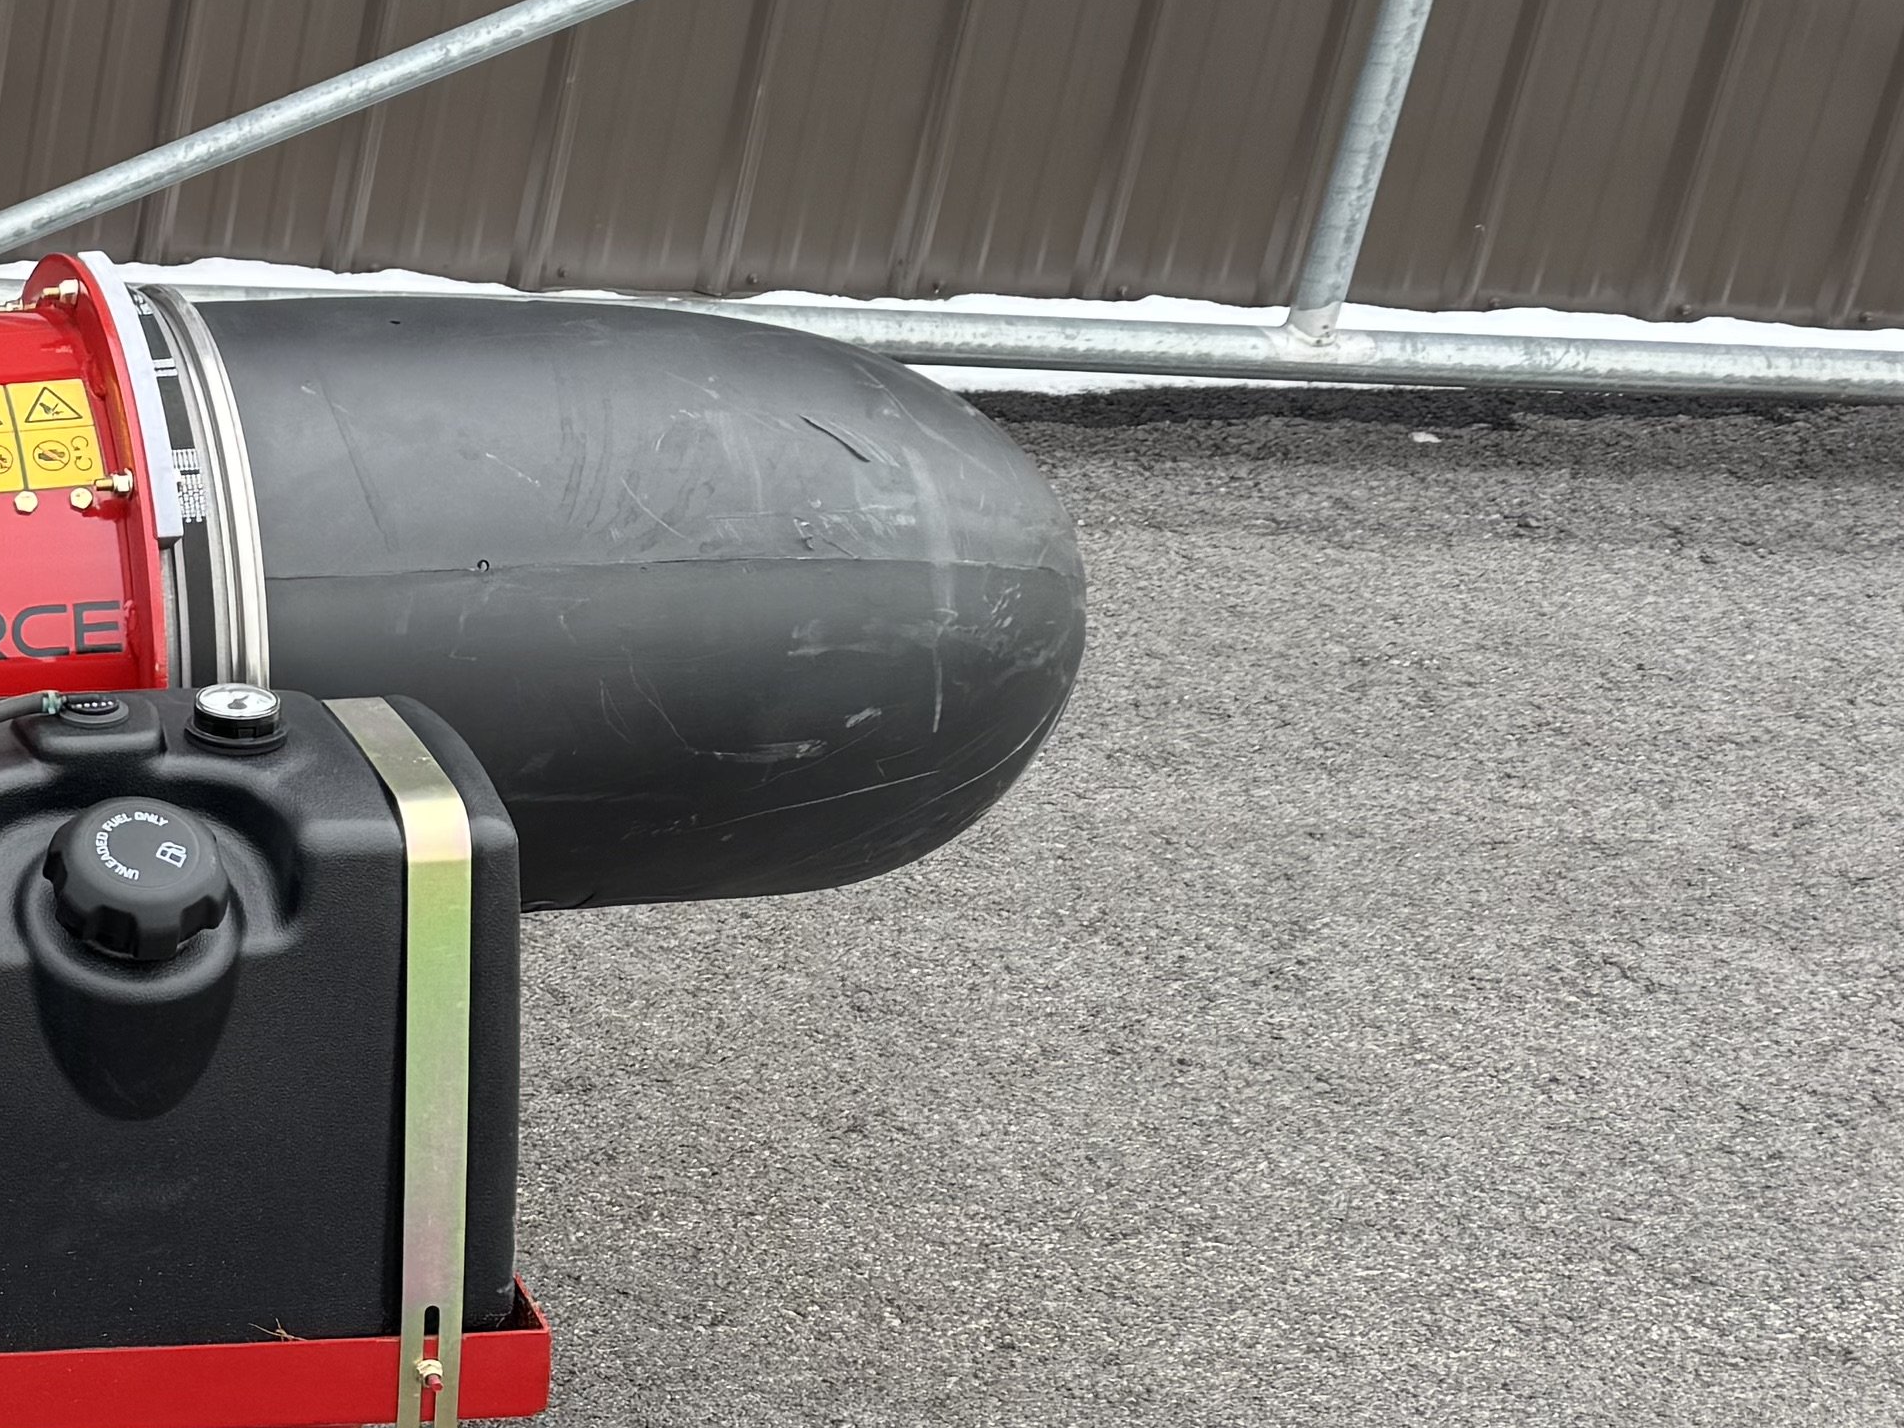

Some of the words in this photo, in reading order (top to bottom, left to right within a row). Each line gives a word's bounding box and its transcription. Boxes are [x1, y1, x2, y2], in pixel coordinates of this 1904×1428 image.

[102, 812, 132, 832] FUEL
[134, 811, 169, 827] ONLY
[95, 831, 140, 881] UNLEADED
